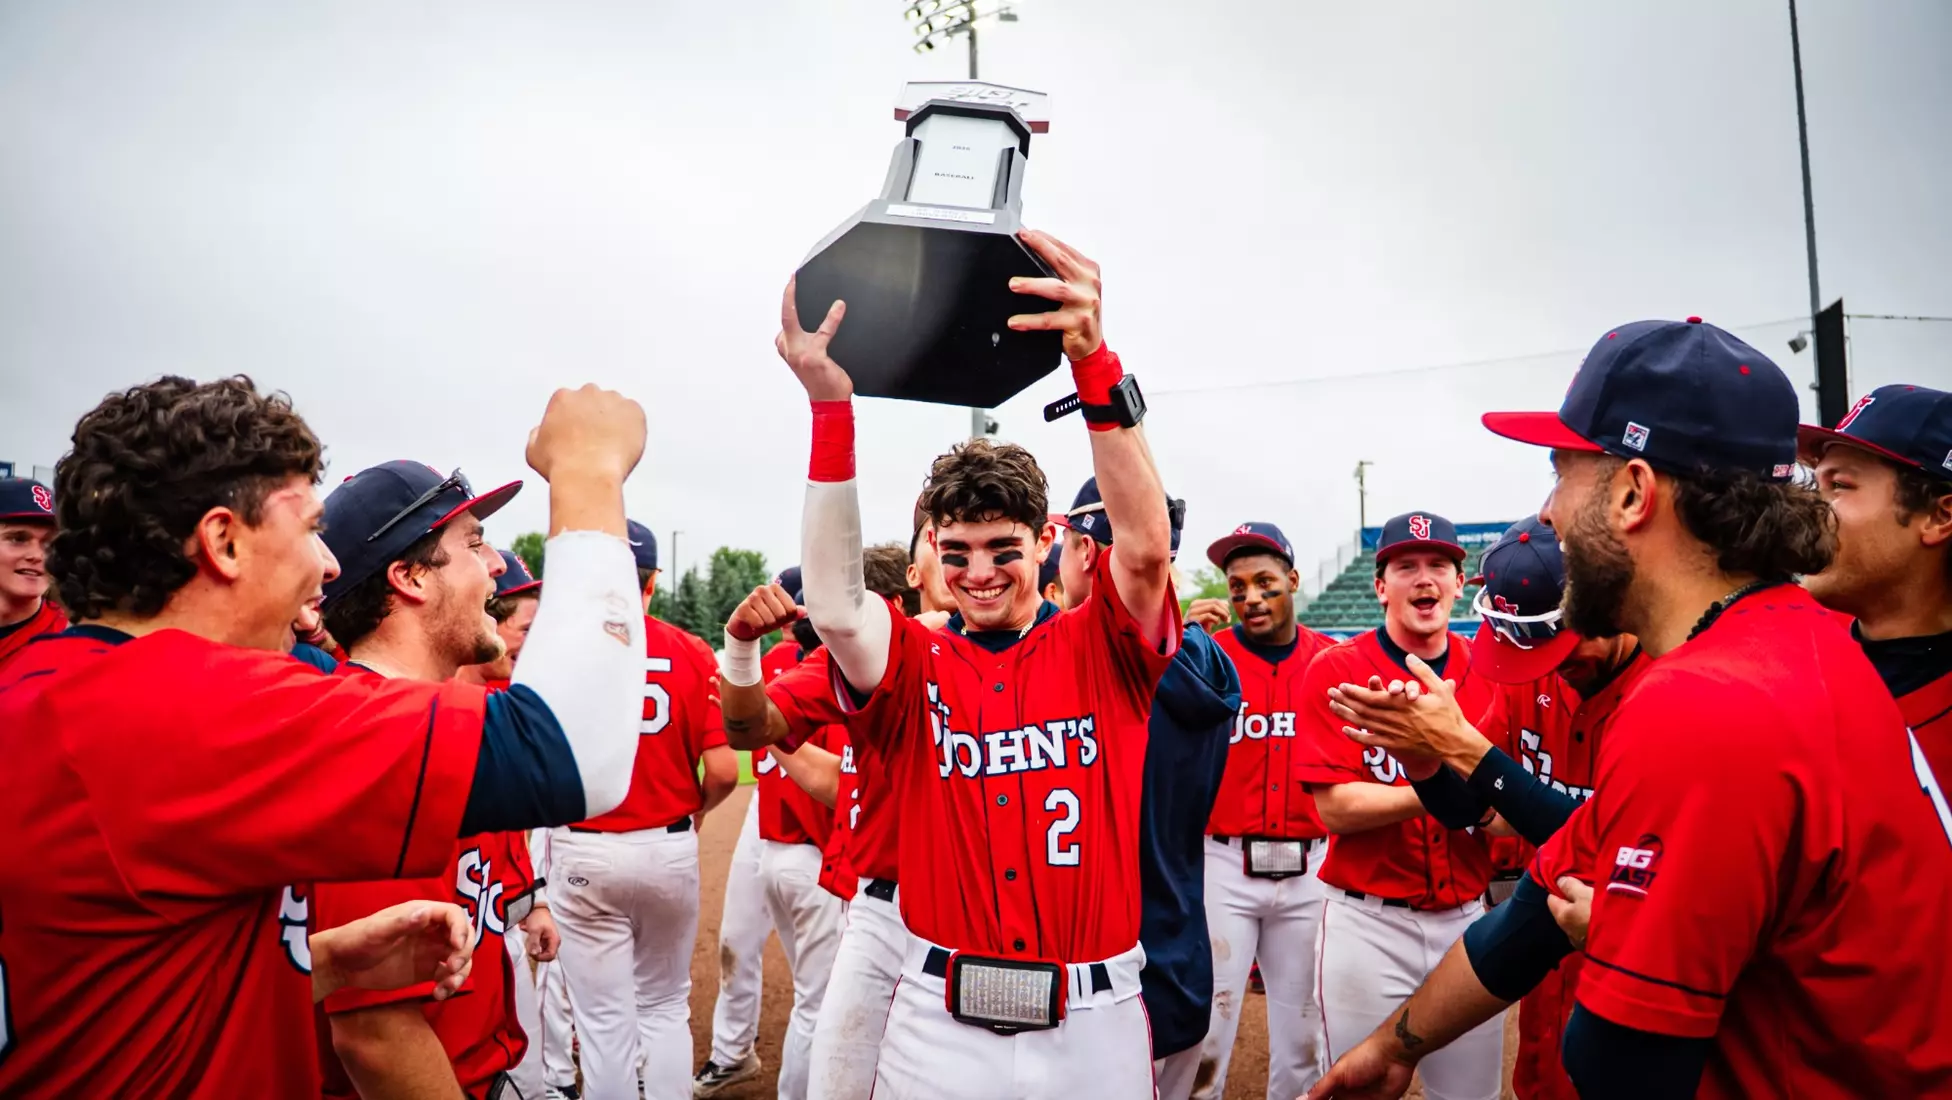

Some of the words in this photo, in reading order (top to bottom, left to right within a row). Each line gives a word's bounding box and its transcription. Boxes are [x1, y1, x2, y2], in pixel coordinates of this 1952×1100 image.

[934, 172, 976, 180] BASEBALL
[1409, 515, 1432, 541] SJ
[1045, 788, 1080, 866] 2
